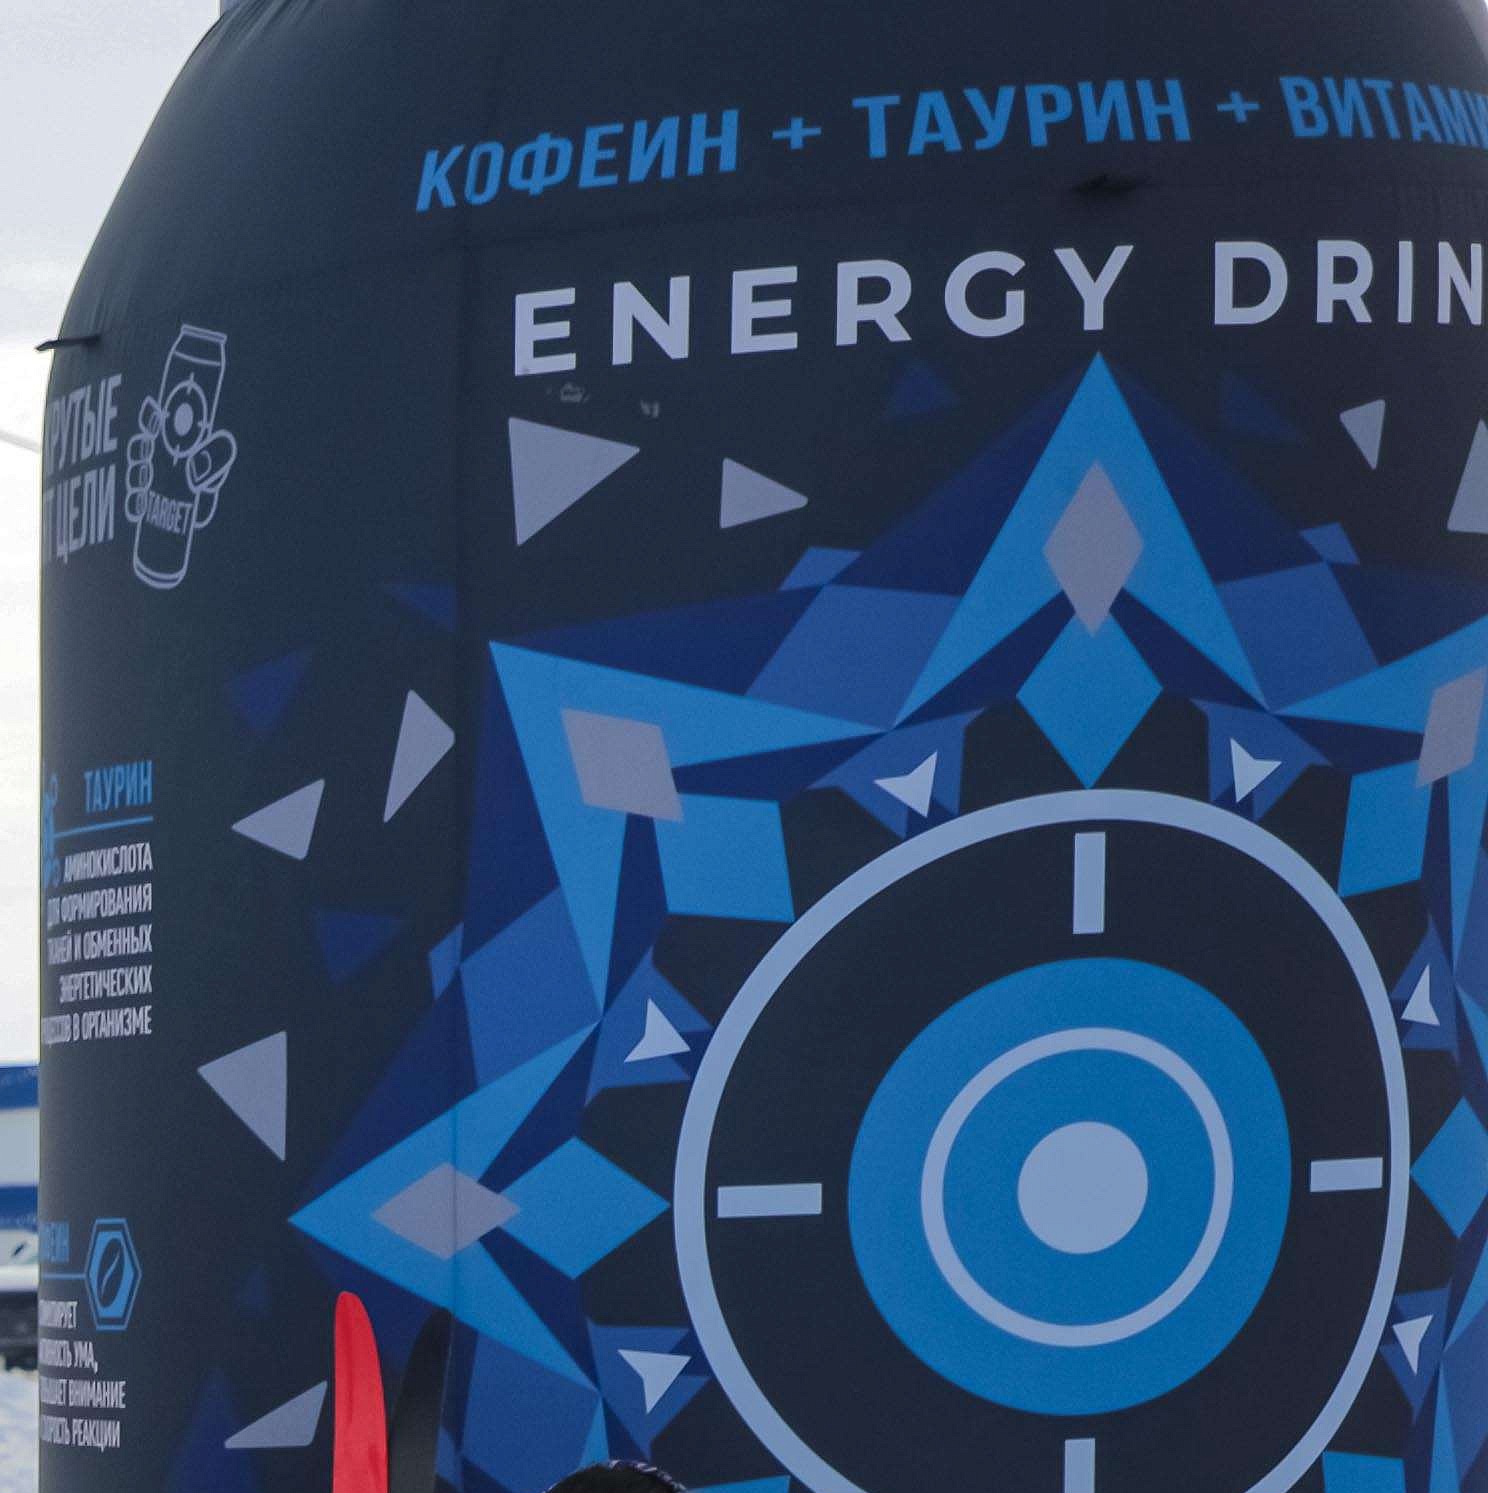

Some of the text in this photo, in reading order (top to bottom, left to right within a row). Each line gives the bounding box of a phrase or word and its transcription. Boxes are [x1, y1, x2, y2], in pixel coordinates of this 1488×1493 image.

[416, 109, 739, 213] КОФЕИН
[852, 78, 1192, 160] ТАУРИН
[514, 239, 1483, 377] ENERGY DRIN
[146, 491, 193, 536] TARGET
[84, 760, 152, 813] ТАУРИН
[81, 1004, 153, 1041] ОРГАНИЗМЕ
[68, 1379, 127, 1409] ВНИМАНИЕ
[72, 1418, 120, 1452] РЕАКЦИИ
